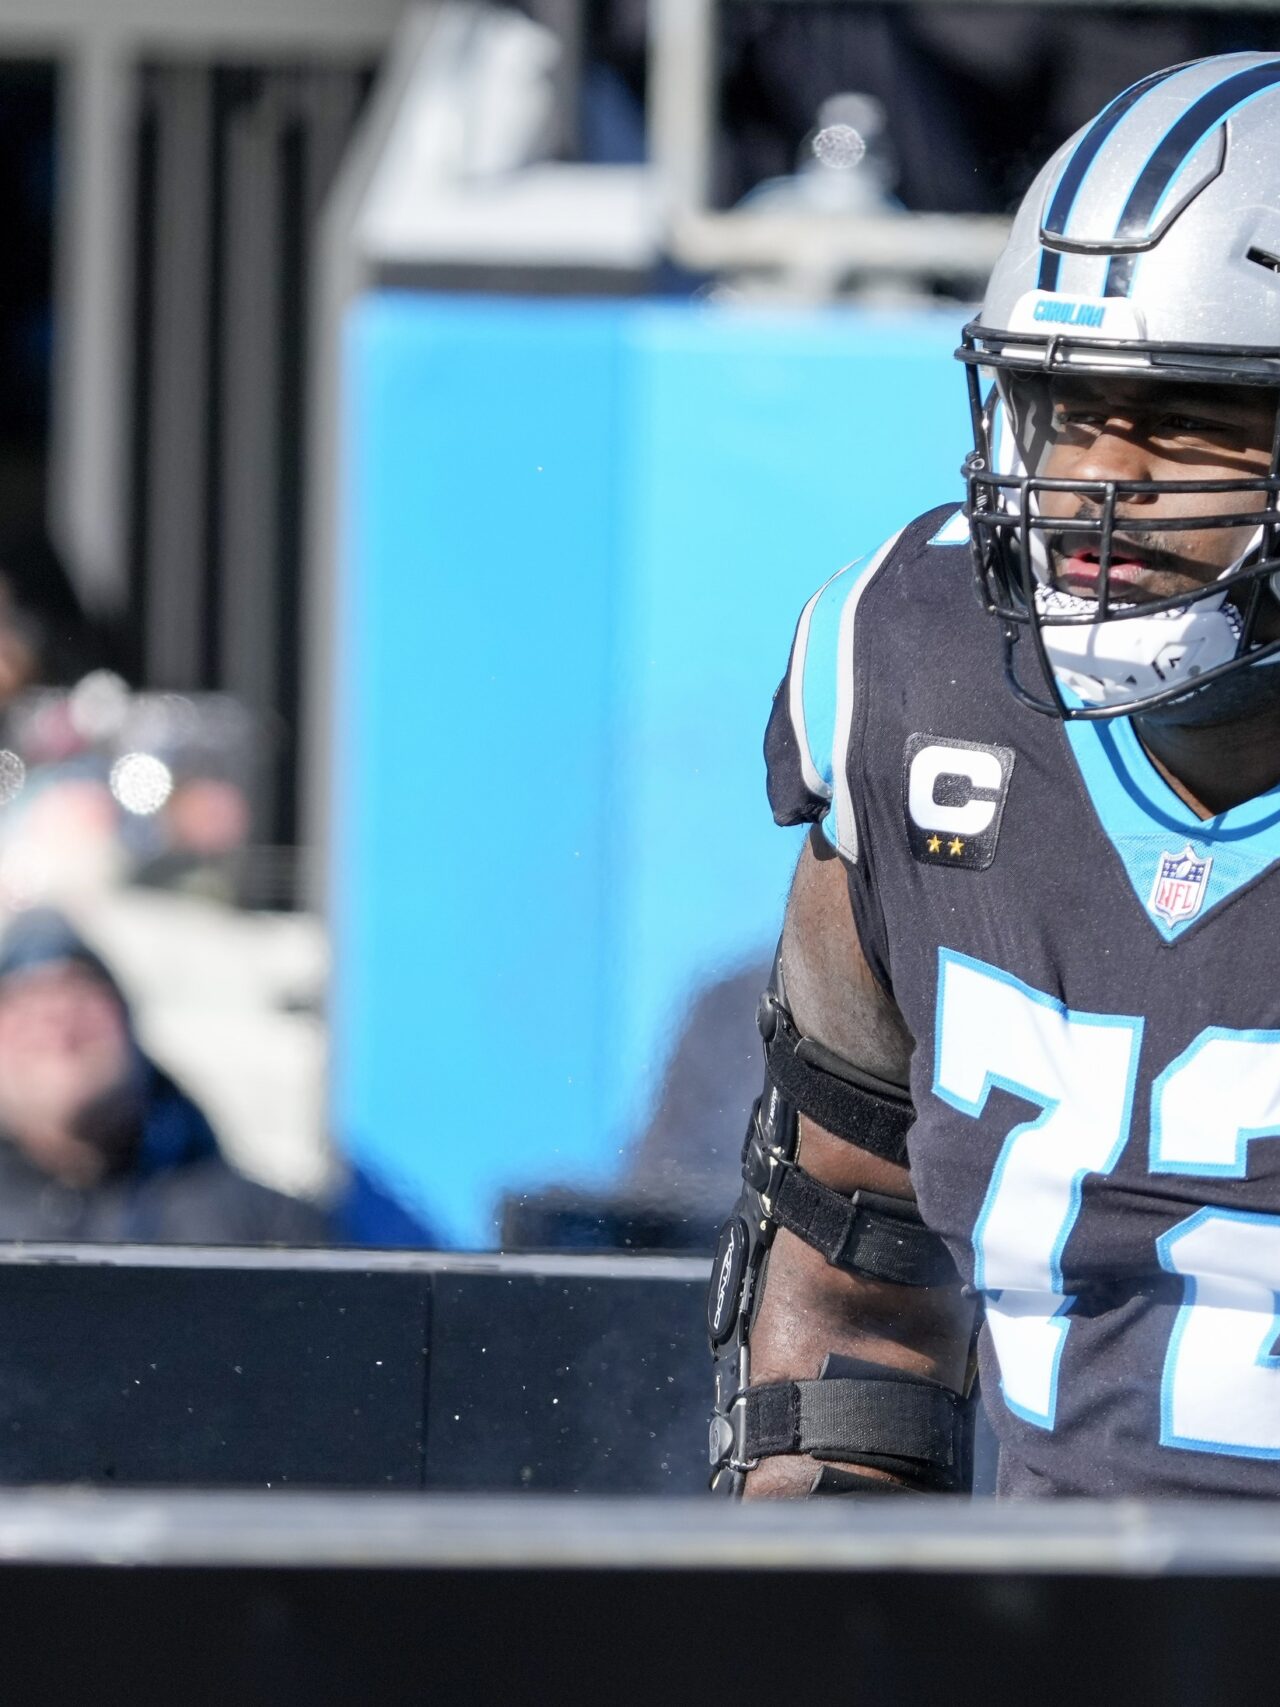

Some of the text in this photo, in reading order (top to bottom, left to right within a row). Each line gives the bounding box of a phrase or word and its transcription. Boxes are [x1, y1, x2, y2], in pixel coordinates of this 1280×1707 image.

[1033, 299, 1106, 328] CAROLINA
[909, 745, 1002, 835] C
[1157, 881, 1192, 911] NFL
